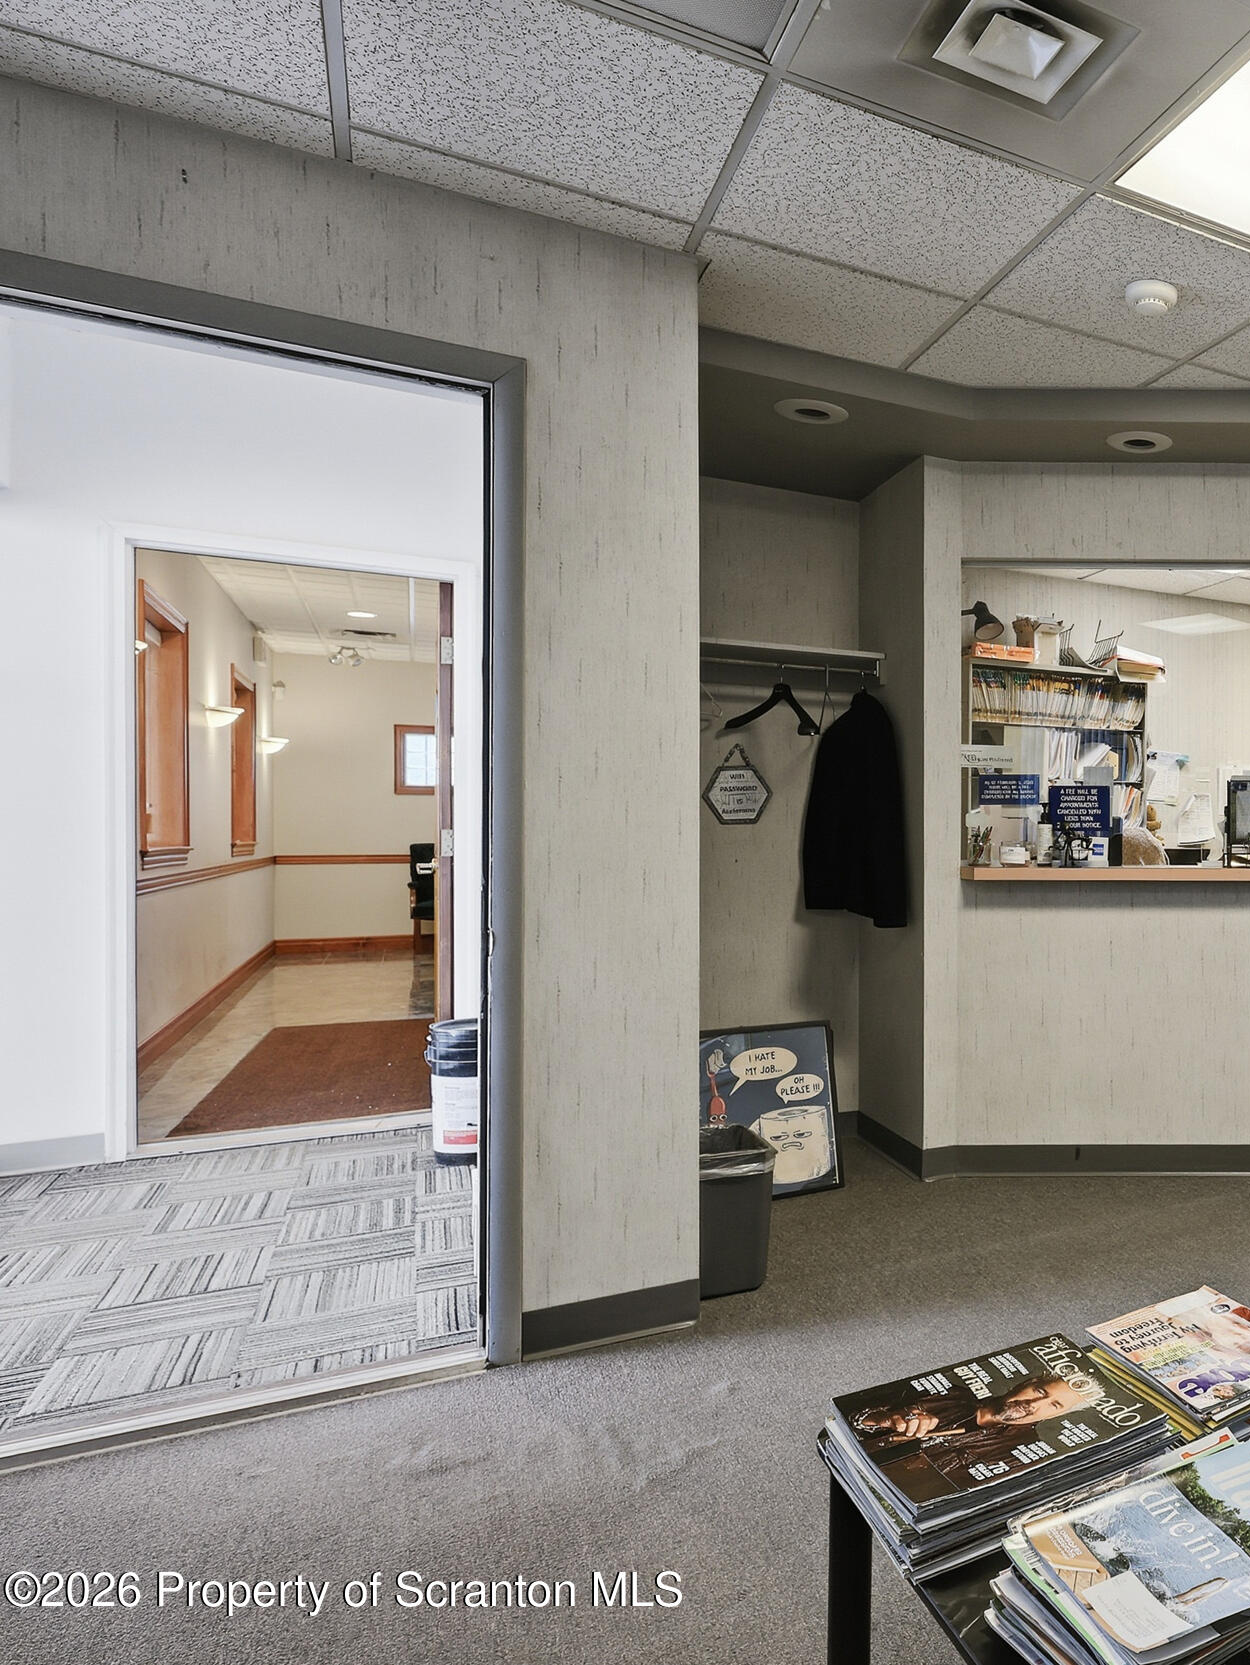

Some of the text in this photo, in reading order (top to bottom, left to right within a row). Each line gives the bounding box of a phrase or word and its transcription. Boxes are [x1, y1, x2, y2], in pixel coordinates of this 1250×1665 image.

[754, 1050, 776, 1061] HATE
[744, 1067, 757, 1076] MY
[793, 1076, 804, 1084] OH
[780, 1084, 810, 1096] PLEASE
[1109, 1317, 1162, 1339] Freedom
[1114, 1320, 1178, 1347] Journey to
[1119, 1323, 1202, 1354] My Terrifying
[953, 1365, 993, 1400] GUY FIERI
[975, 1370, 994, 1384] REAL
[987, 1460, 1010, 1475] 76
[1138, 1489, 1240, 1570] dive in!
